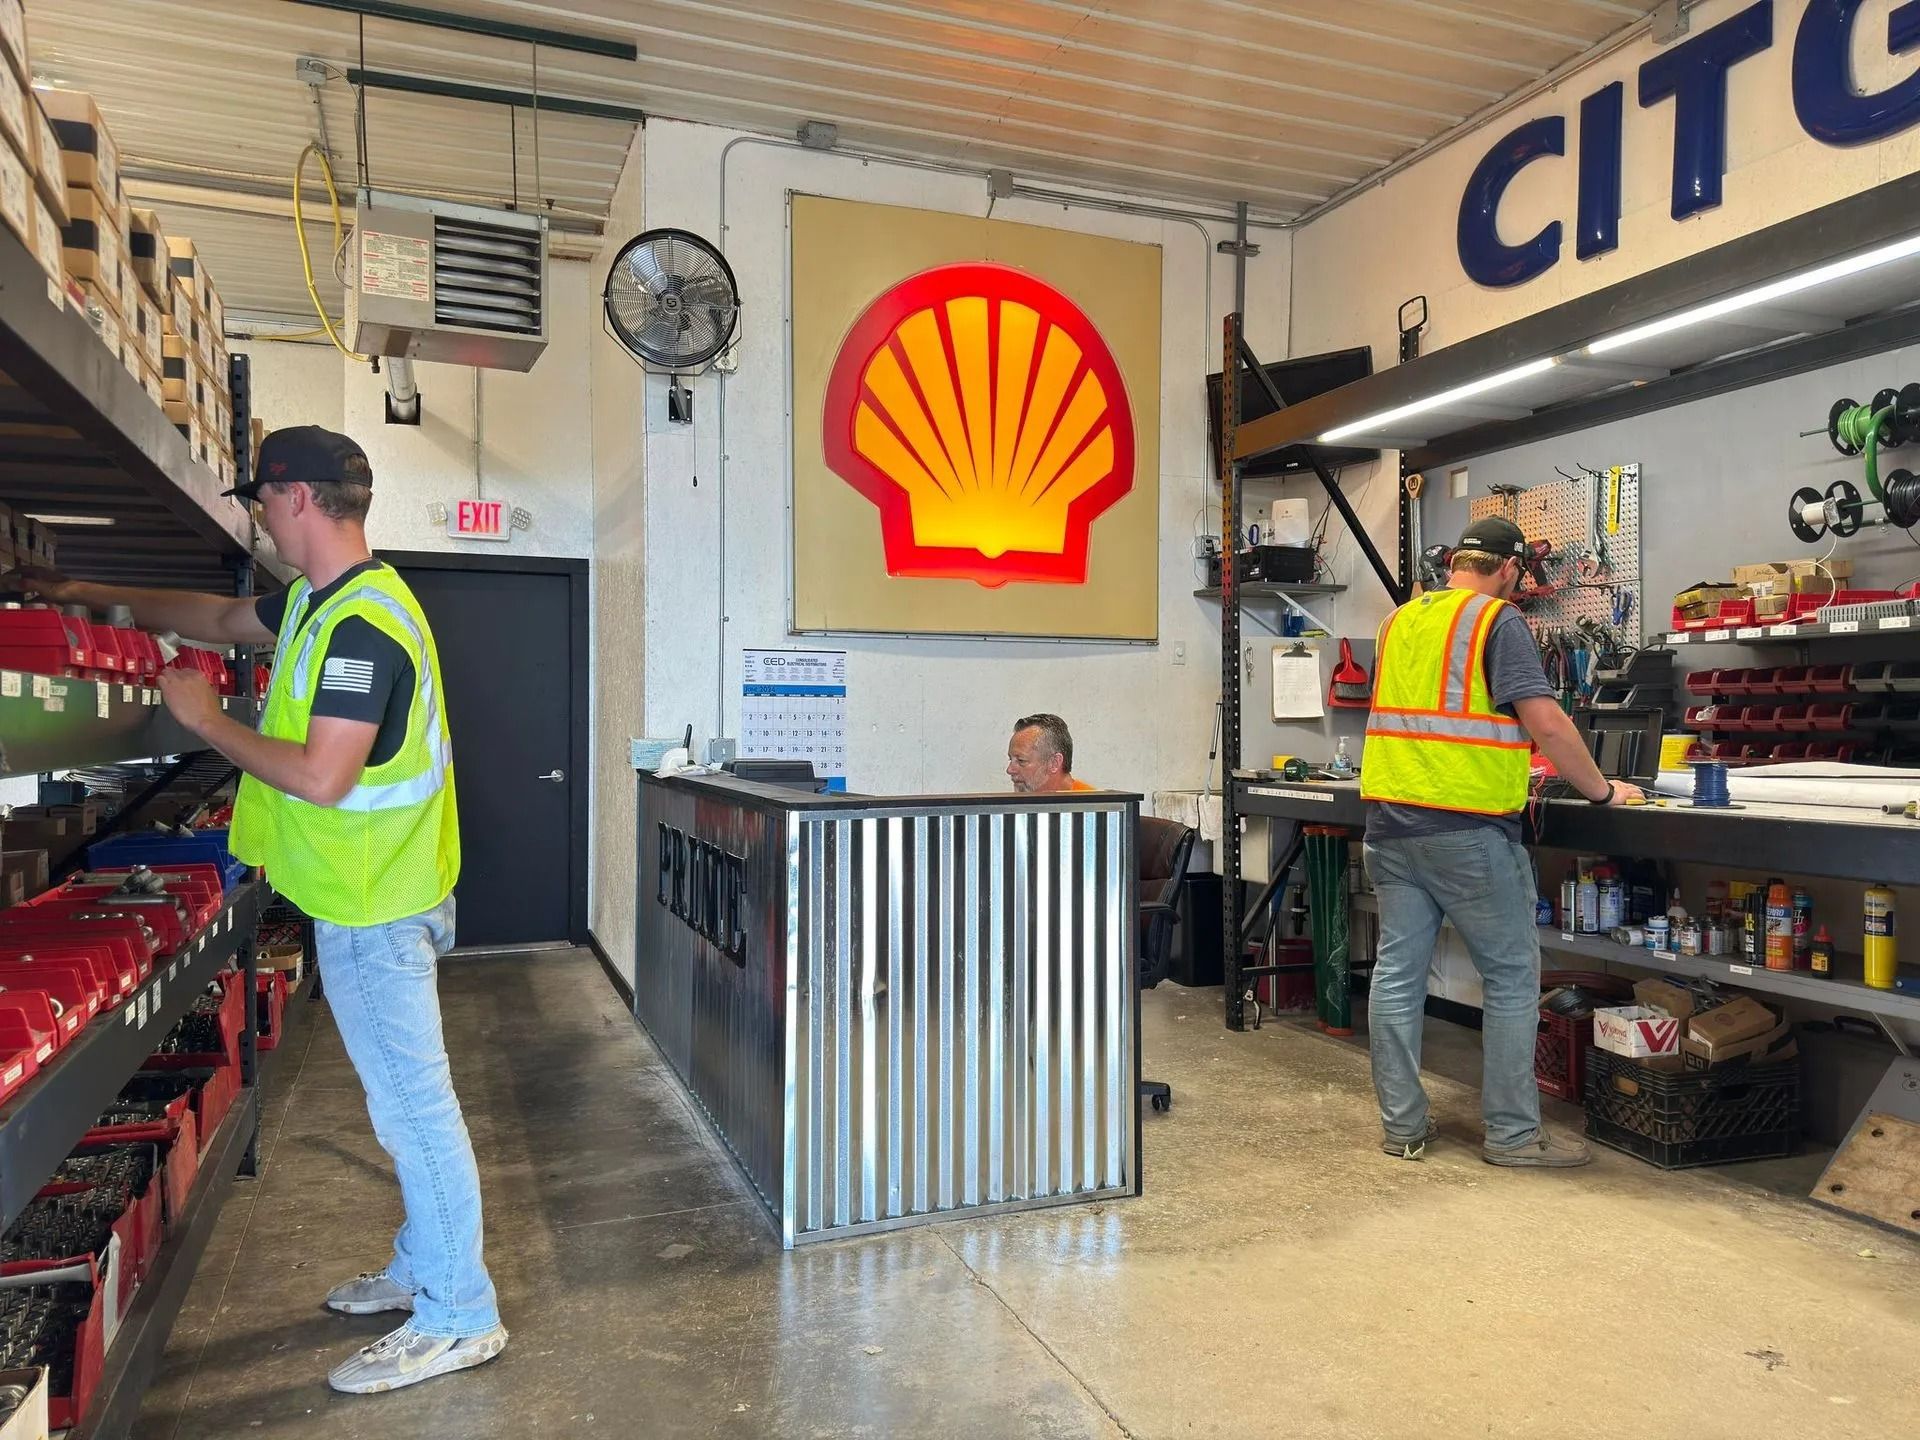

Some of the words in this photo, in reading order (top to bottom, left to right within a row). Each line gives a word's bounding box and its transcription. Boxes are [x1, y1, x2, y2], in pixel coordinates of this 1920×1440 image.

[1457, 0, 1920, 289] CITG
[458, 500, 502, 534] EXIT
[763, 657, 786, 666] CED
[657, 820, 748, 969] PRIME
[1766, 908, 1784, 917] ERRO
